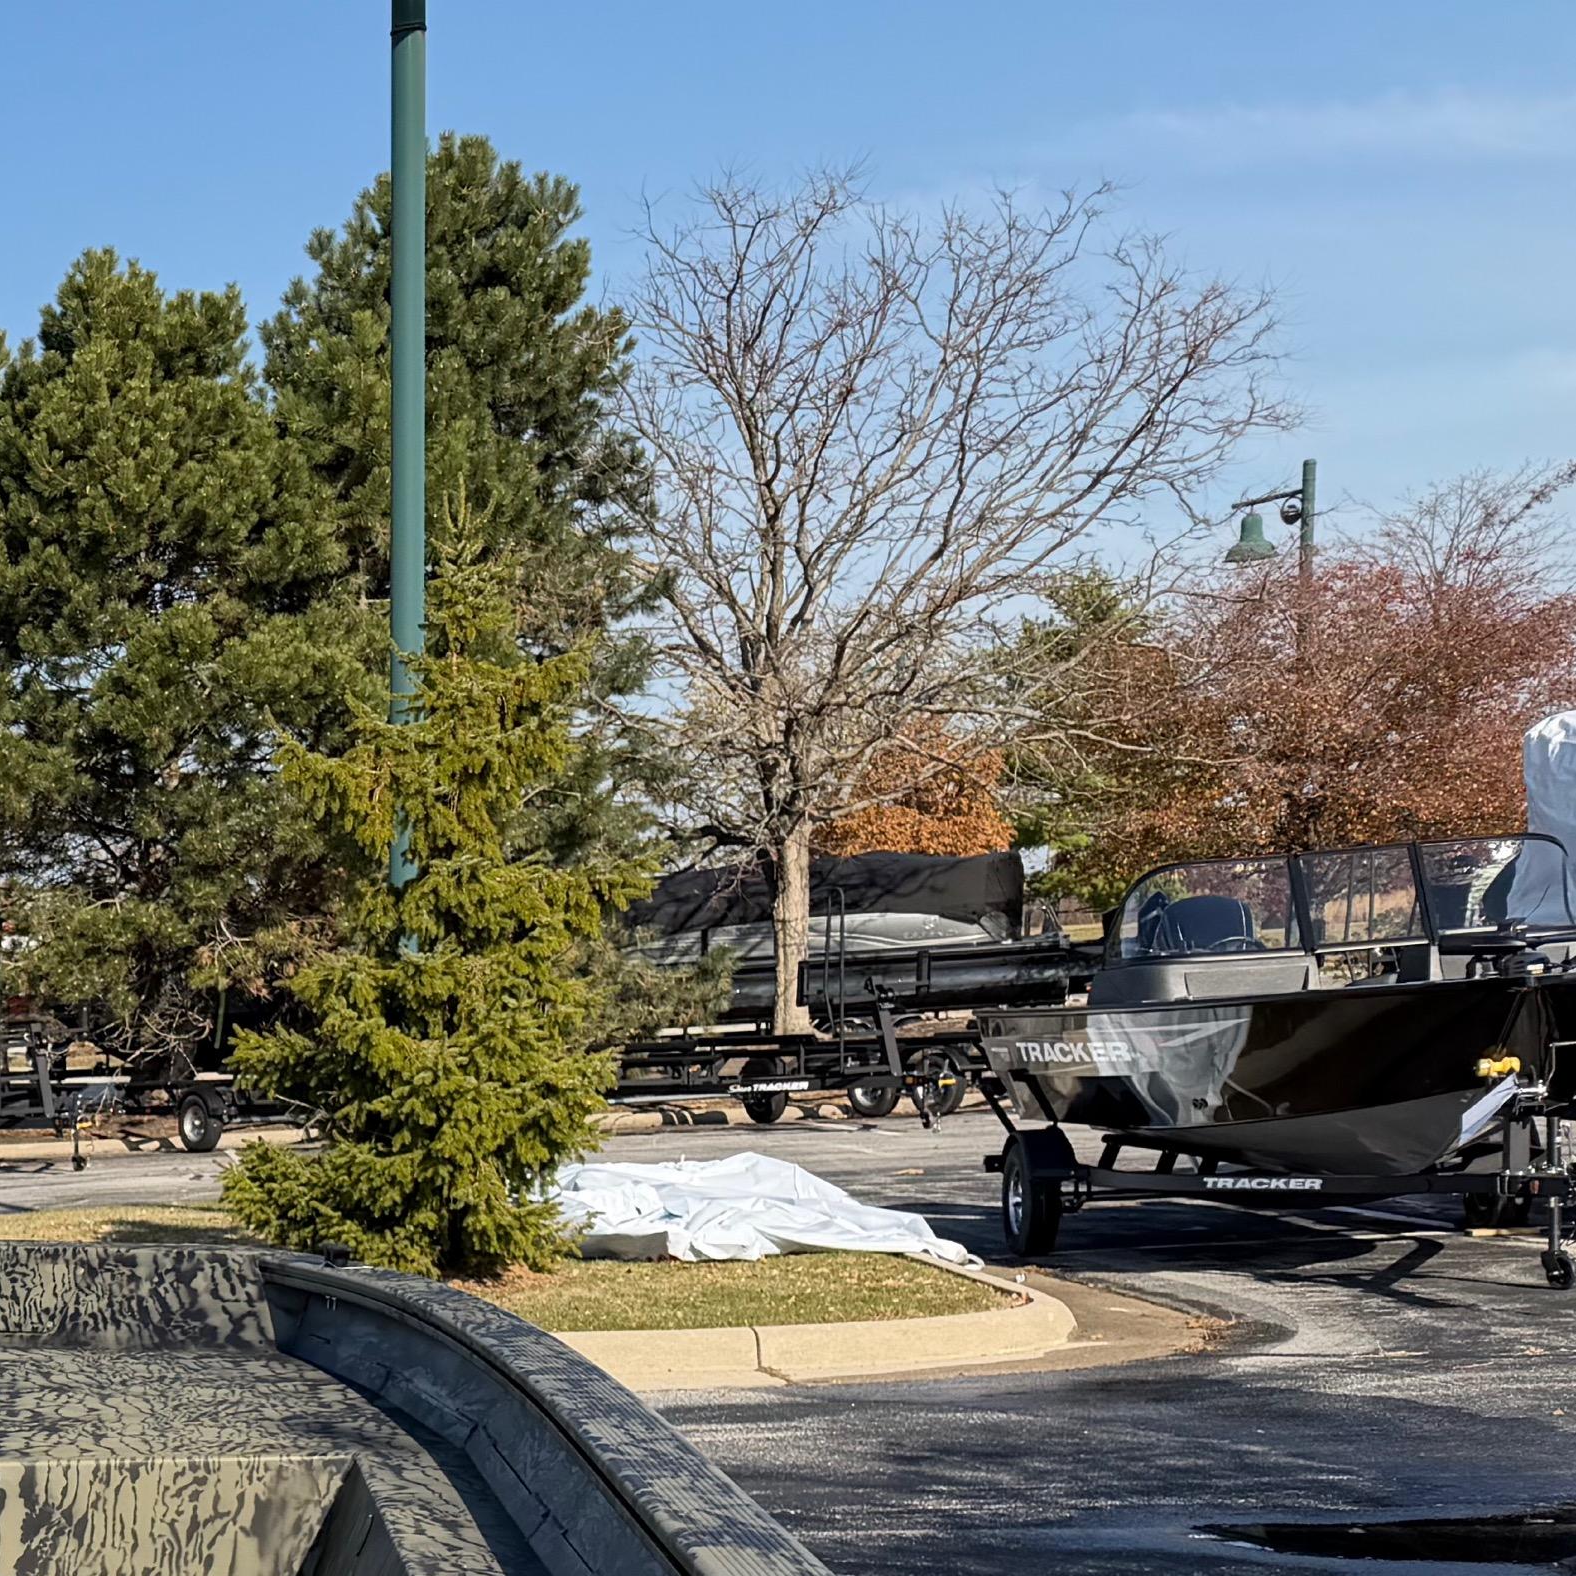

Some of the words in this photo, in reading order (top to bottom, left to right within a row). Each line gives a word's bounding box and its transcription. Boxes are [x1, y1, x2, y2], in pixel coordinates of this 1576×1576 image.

[1016, 1041, 1133, 1063] TRACKER
[753, 1081, 809, 1092] TRACKER
[1203, 1177, 1323, 1190] TRACKER
